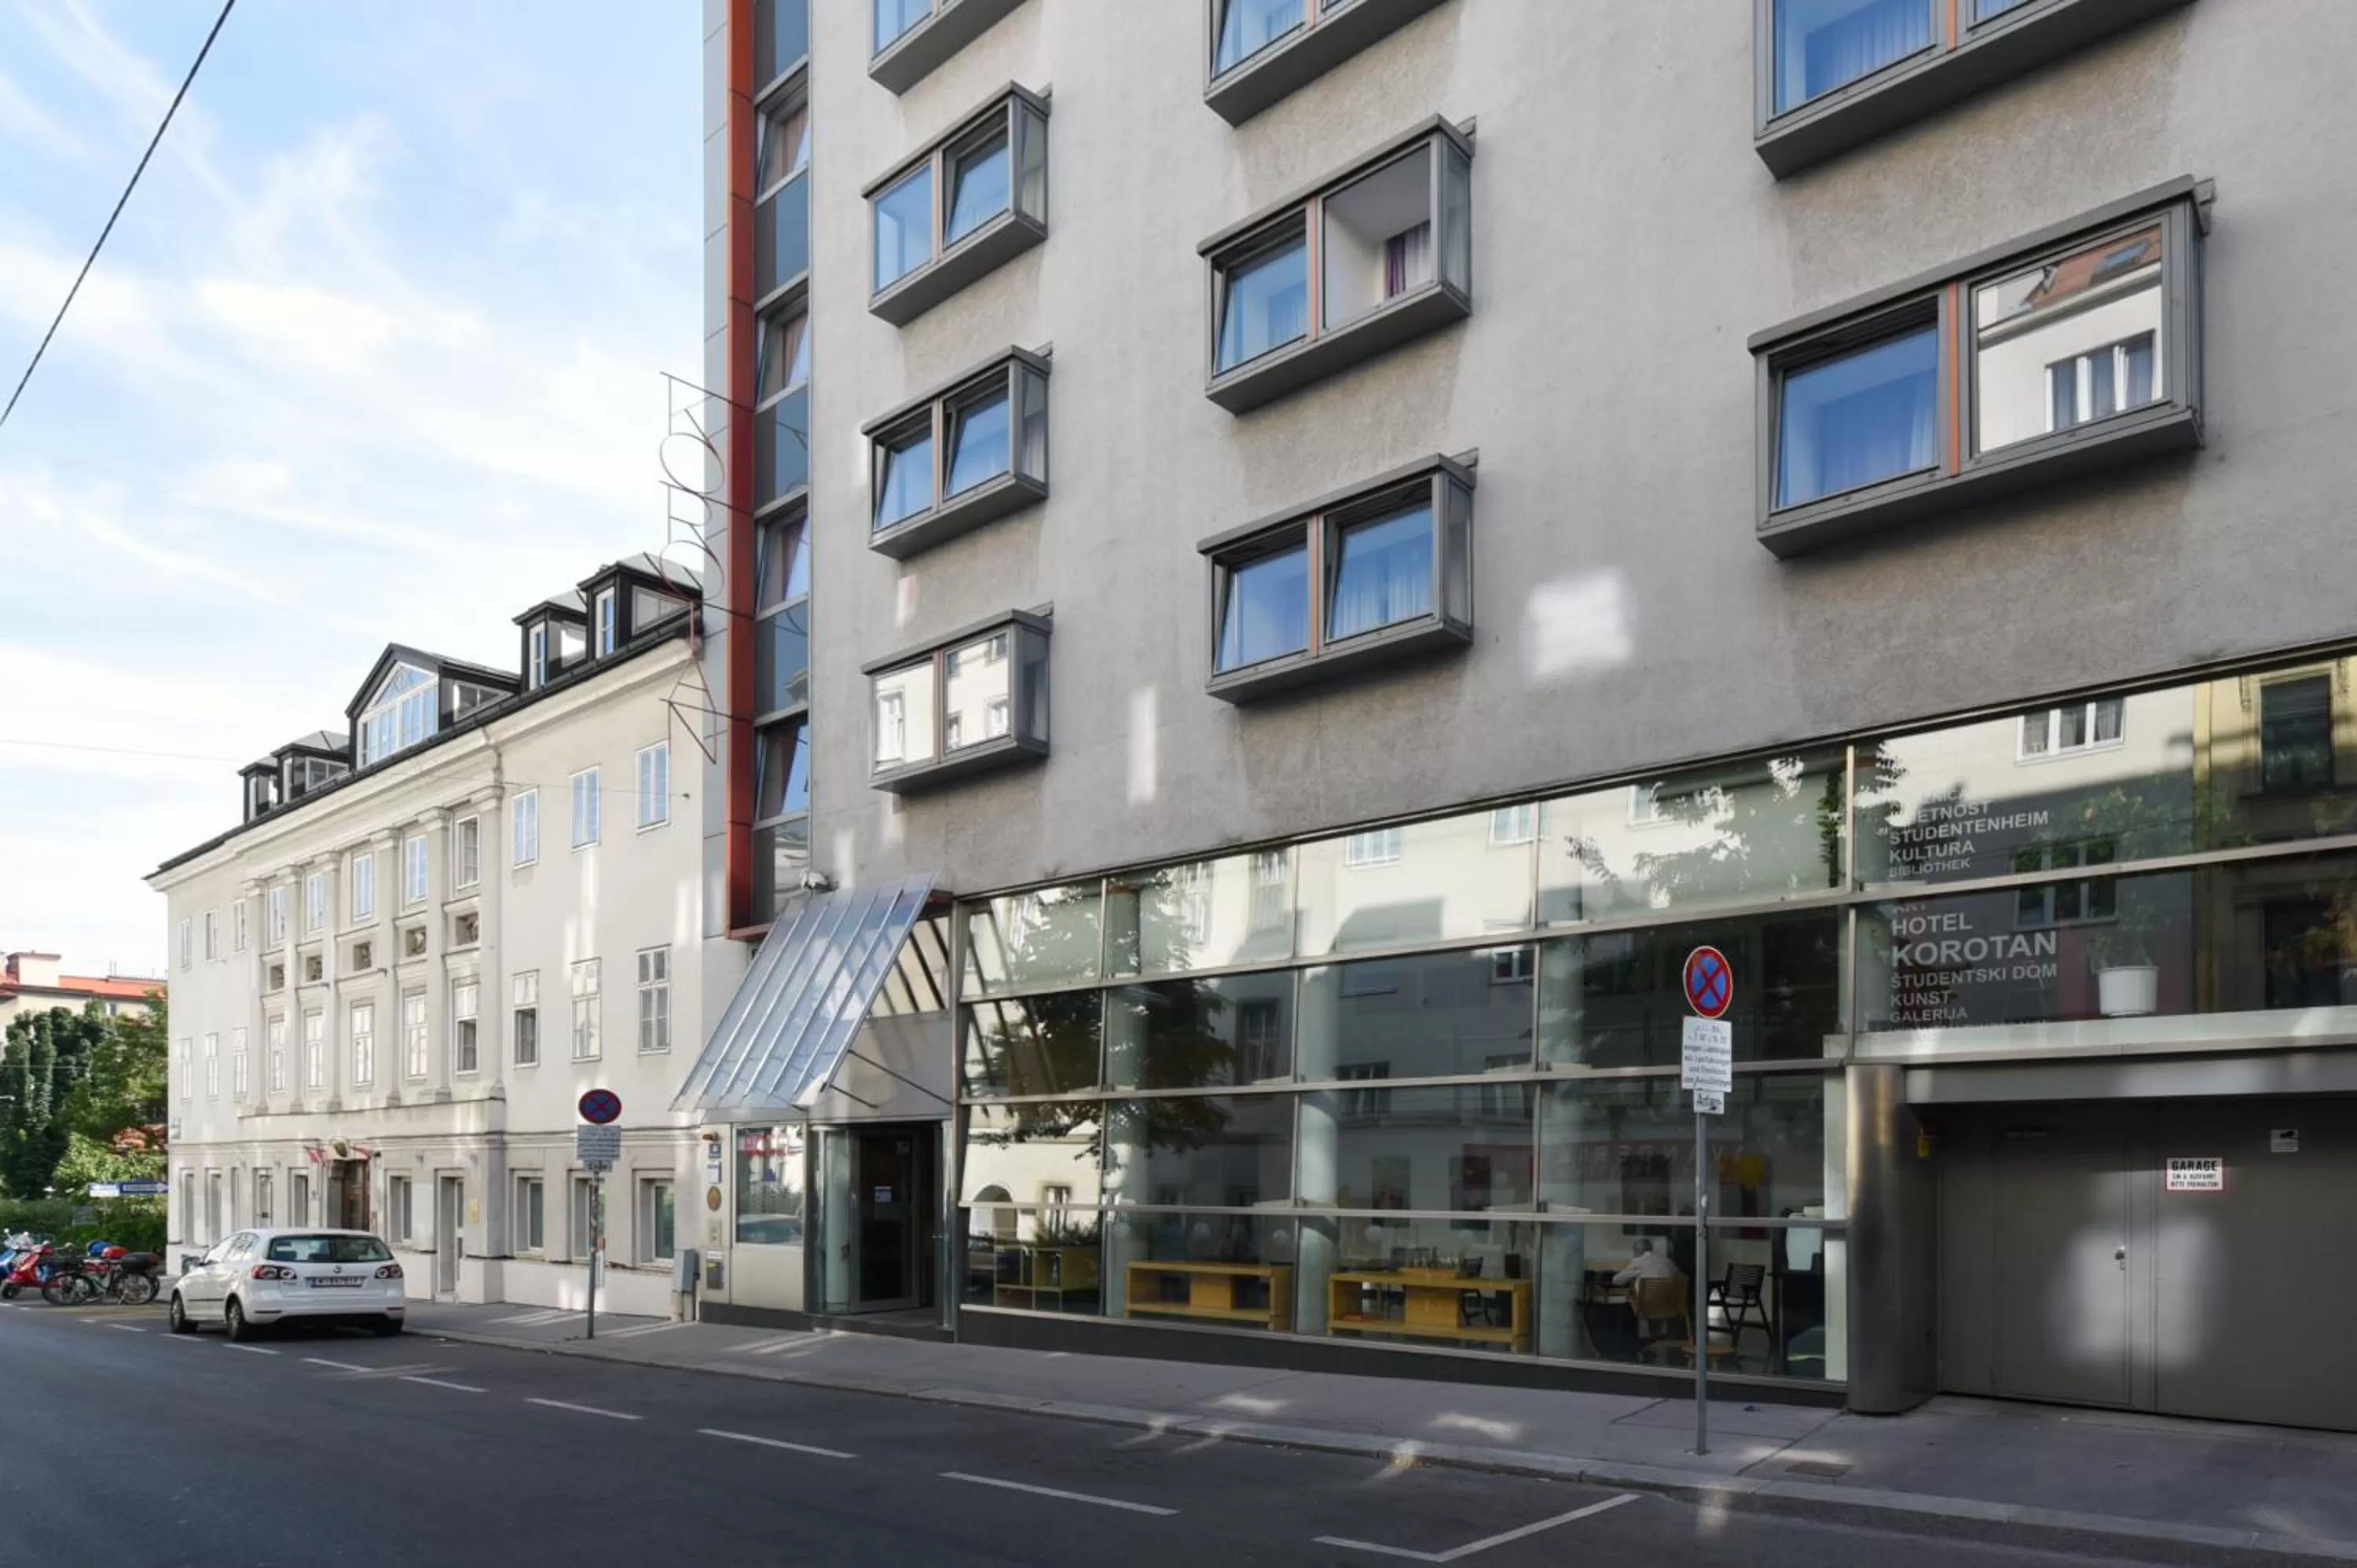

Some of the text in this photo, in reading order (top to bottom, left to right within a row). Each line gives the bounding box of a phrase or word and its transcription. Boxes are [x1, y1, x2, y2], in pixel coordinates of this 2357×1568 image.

[1889, 810, 2049, 846] STUDENTENHEIM
[1889, 840, 1975, 863] KULTURA
[1888, 857, 1971, 878] BIBLIOTHEK
[1891, 913, 1974, 936] HOTEL
[1891, 931, 2056, 968] KOROTAN
[2012, 962, 2057, 980] DOM
[1890, 990, 1952, 1006] KUNST
[1890, 1006, 1968, 1023] GALERIJA
[2172, 1160, 2218, 1171] GARAGE
